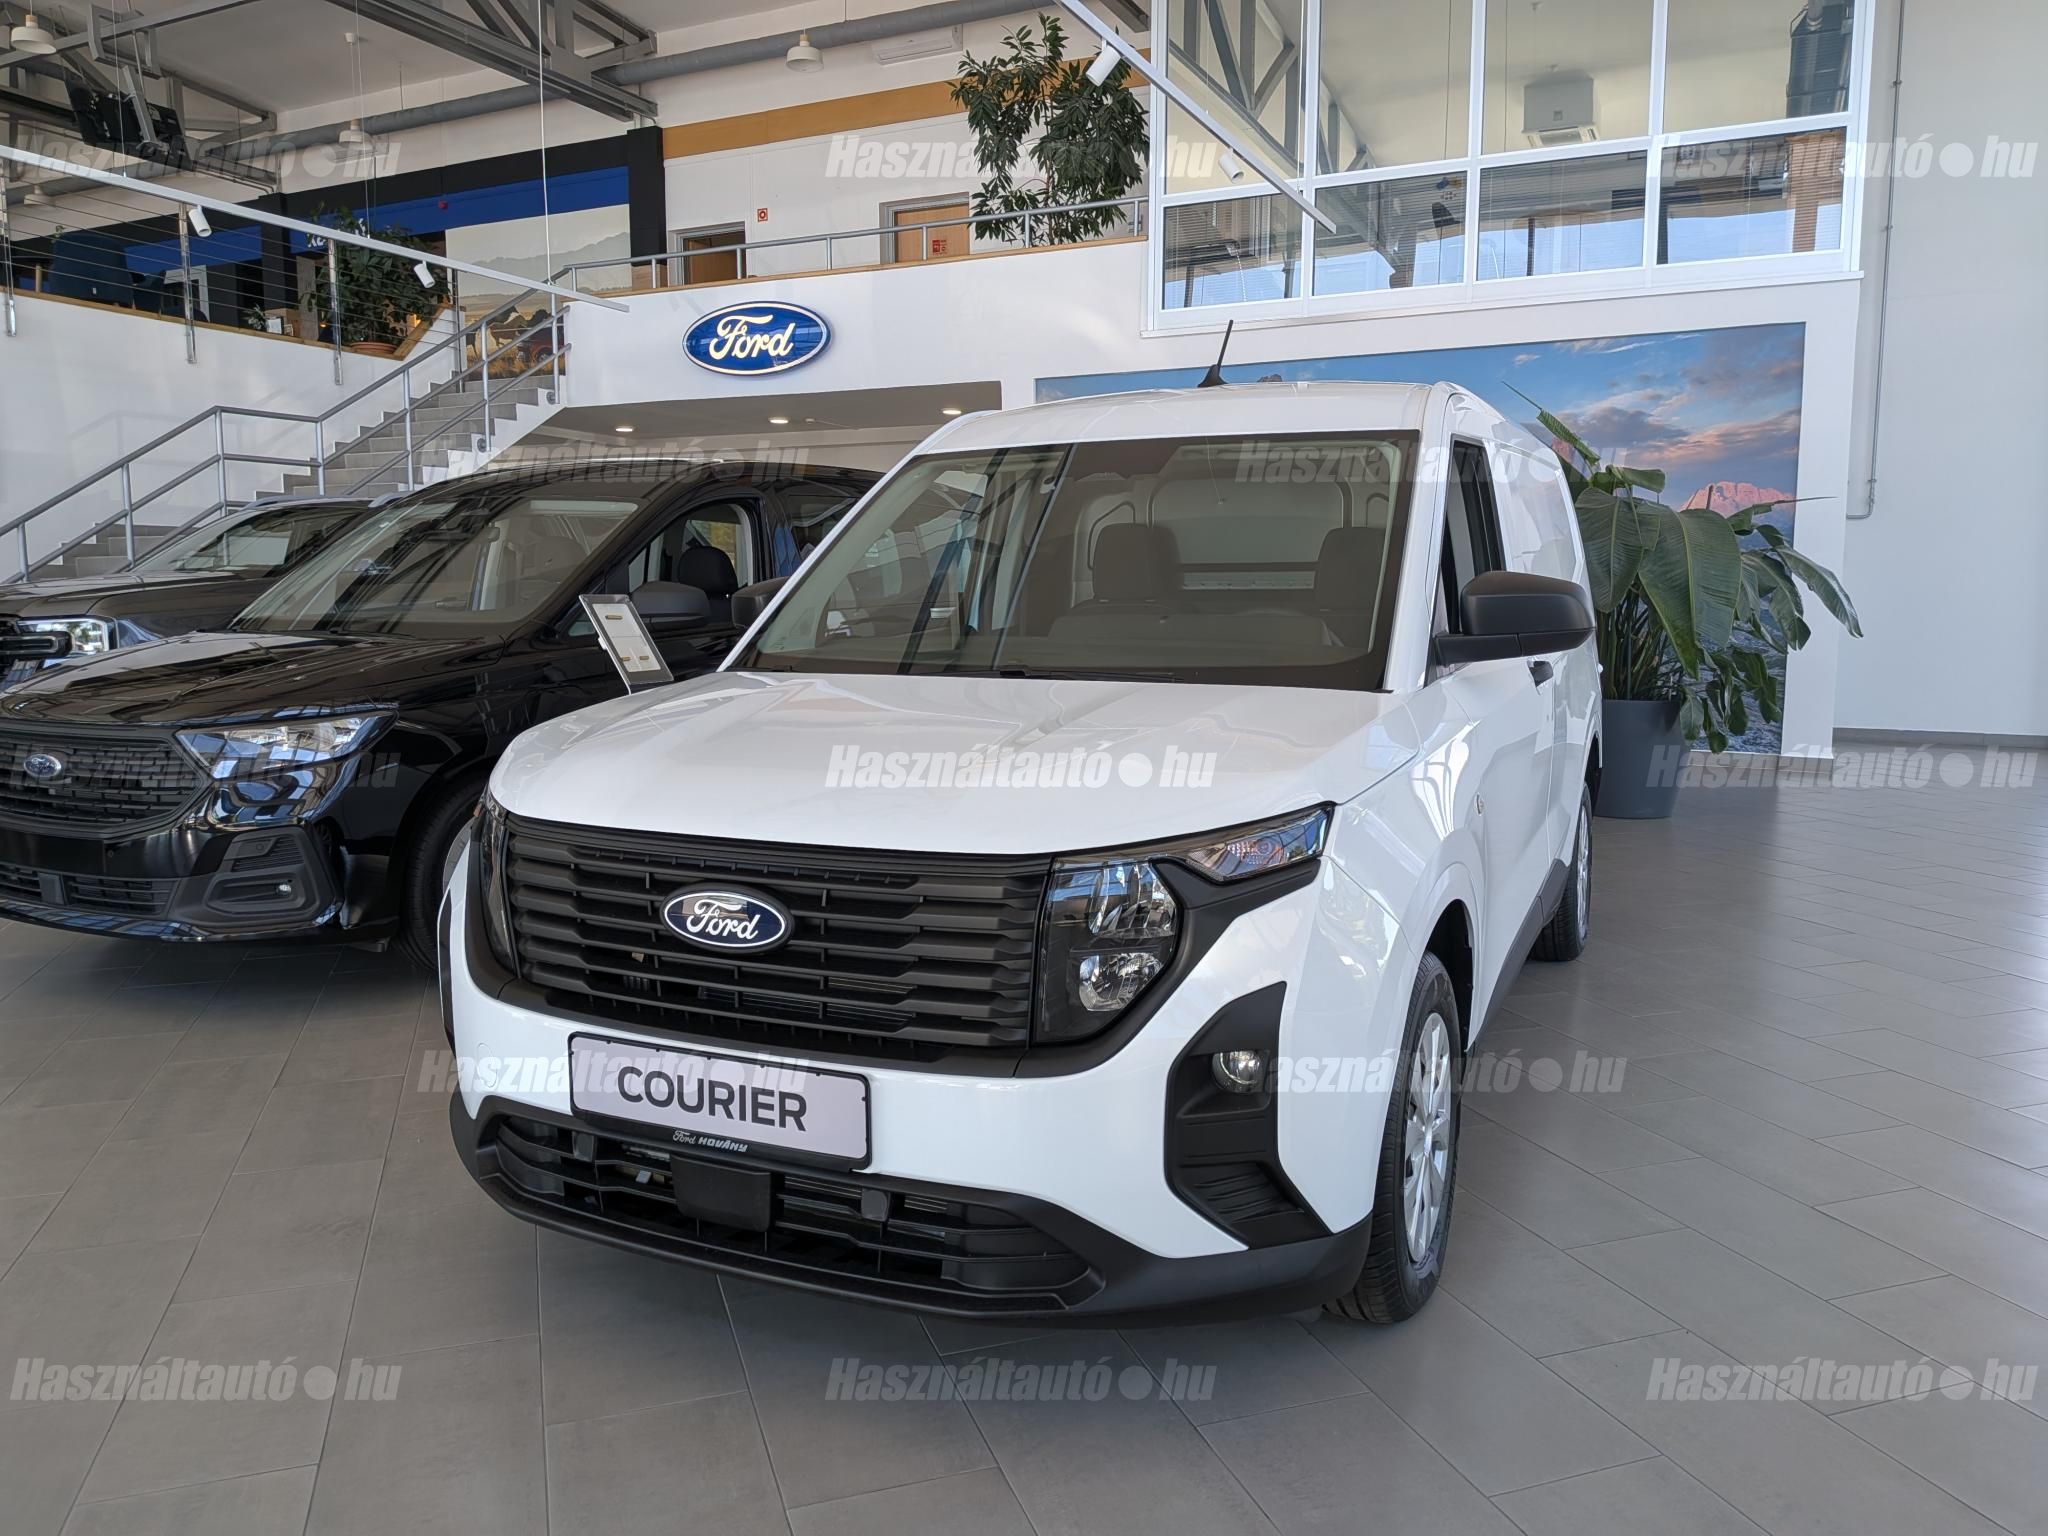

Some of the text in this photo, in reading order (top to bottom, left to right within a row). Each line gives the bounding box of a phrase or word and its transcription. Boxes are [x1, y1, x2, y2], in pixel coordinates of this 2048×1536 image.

[709, 315, 795, 359] Ford
[686, 899, 761, 940] Ford
[616, 1066, 807, 1131] COURIER
[672, 1130, 697, 1144] Ford
